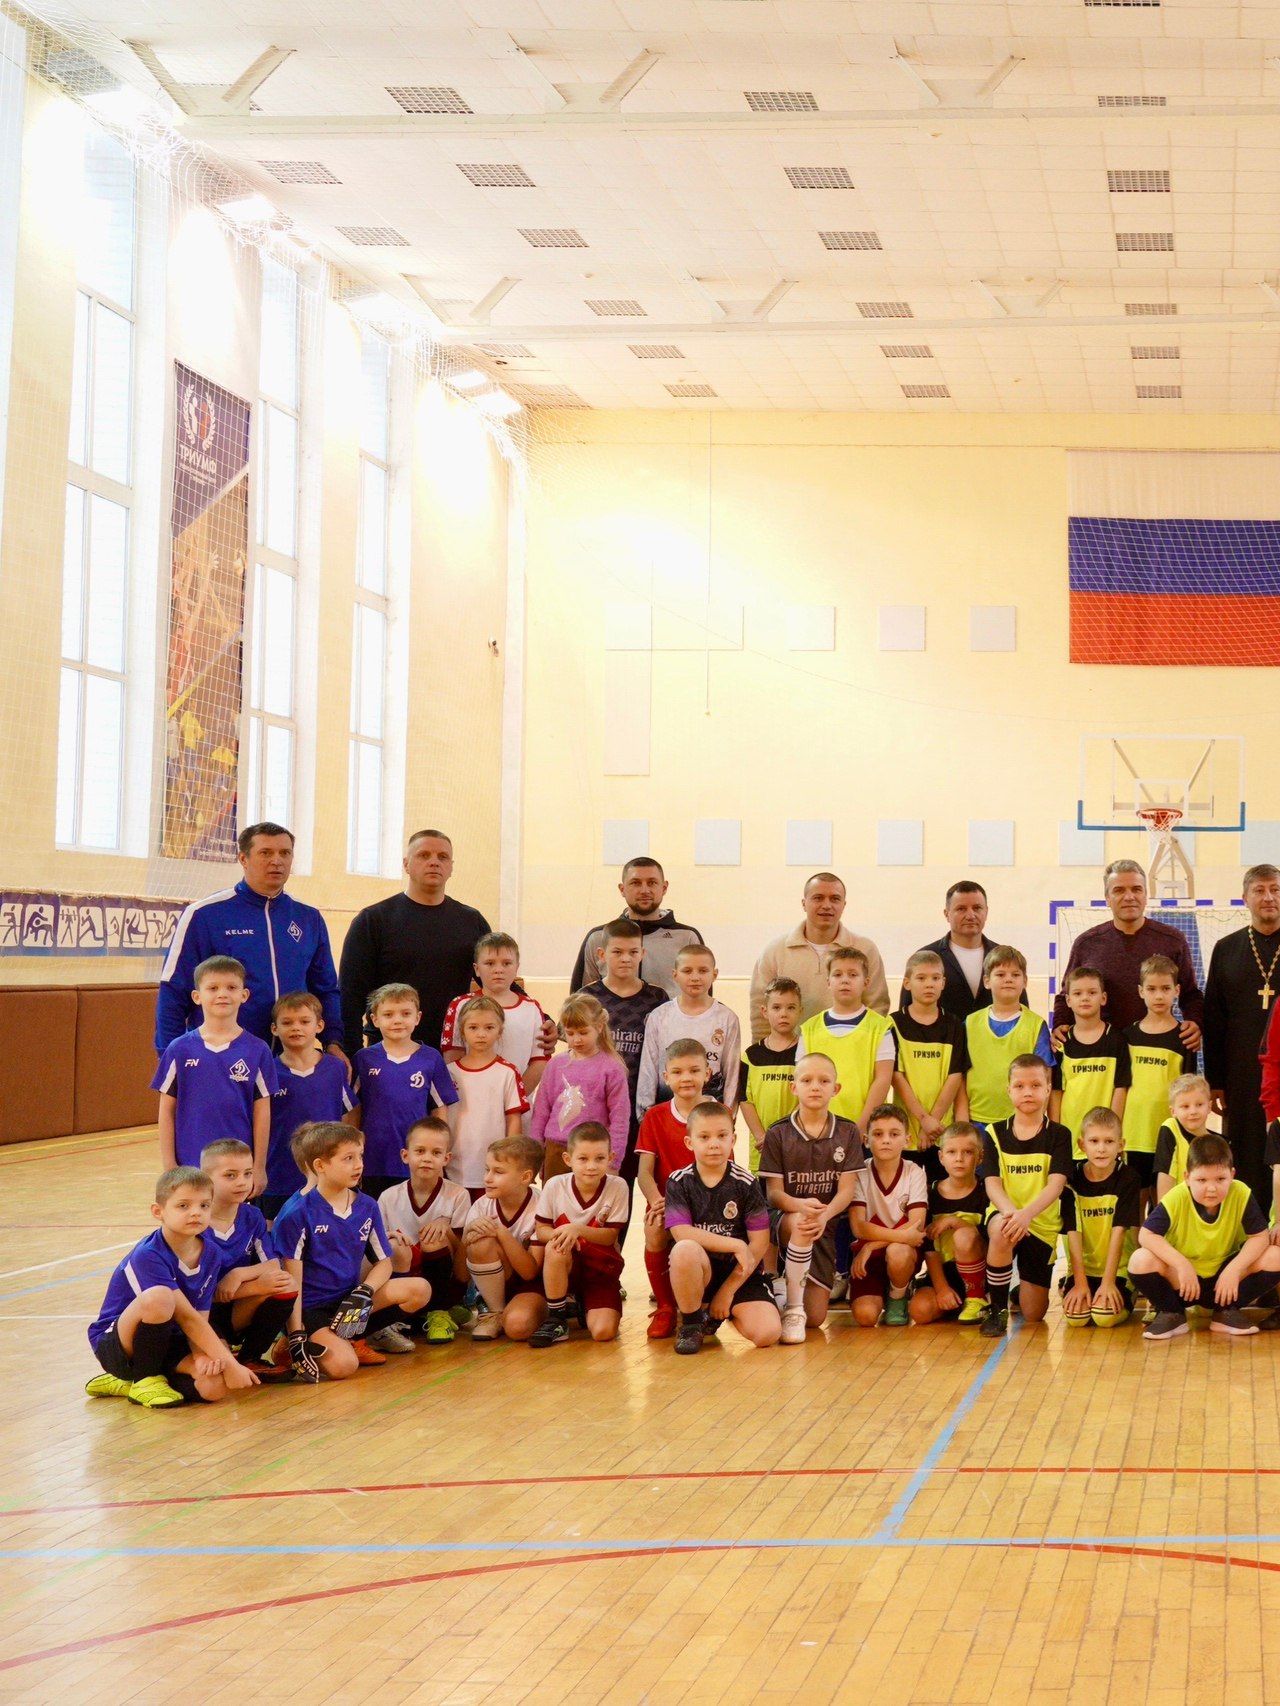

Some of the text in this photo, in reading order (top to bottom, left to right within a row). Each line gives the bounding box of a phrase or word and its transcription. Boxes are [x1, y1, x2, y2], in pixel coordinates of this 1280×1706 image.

[179, 444, 217, 475] ТРИУМФ
[913, 1050, 941, 1059] ТРИУМФ
[1135, 1055, 1168, 1066] ТРИУМФ
[1072, 1064, 1107, 1074] ТРИУМФ
[761, 1073, 795, 1081] ТРИУМФ
[1006, 1164, 1042, 1174] ТРИУМФ
